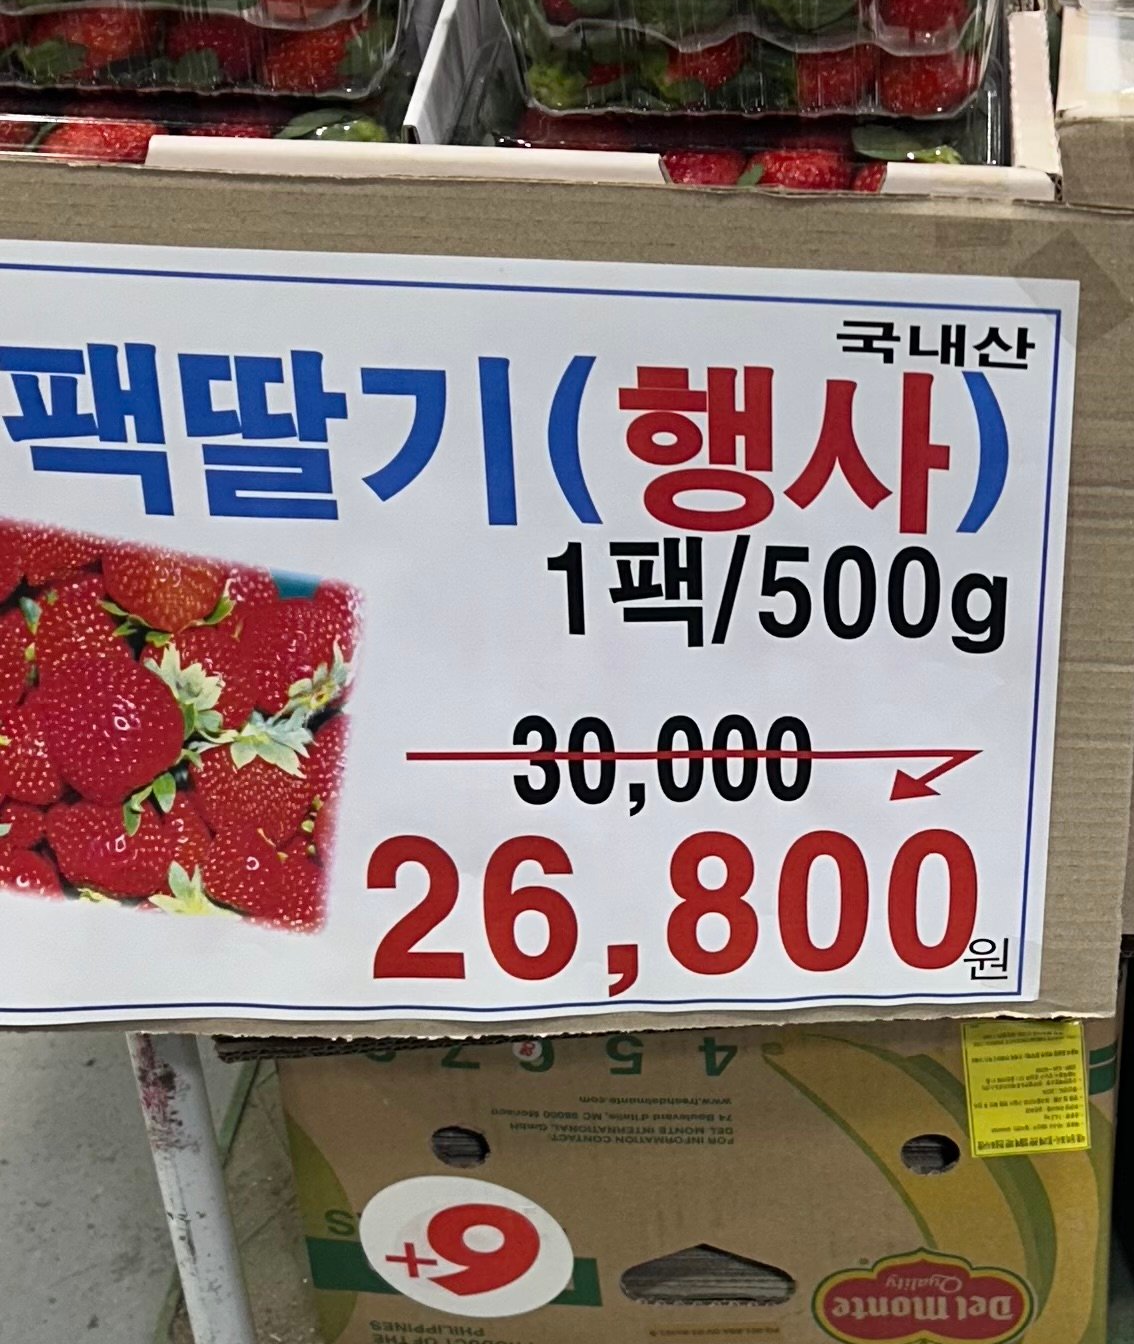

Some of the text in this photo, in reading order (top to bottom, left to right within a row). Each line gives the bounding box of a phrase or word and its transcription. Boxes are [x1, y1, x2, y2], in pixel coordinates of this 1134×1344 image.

[836, 320, 1036, 370] 국내산
[0, 342, 1008, 534] 팩딸기(행사)
[547, 534, 1008, 654] 1팩/500g
[512, 714, 812, 817] 30,000
[606, 1035, 645, 1075] 5
[698, 1037, 738, 1077] 4
[615, 1135, 704, 1144] INFORMATION
[659, 1126, 705, 1134] MONTE
[707, 1136, 734, 1145] FOR
[709, 1127, 733, 1135] DEL
[885, 1274, 963, 1293] Quality
[830, 1295, 1013, 1320] Del Monte
[369, 1320, 484, 1337] PHILIPPINES
[372, 1334, 408, 1344] THE
